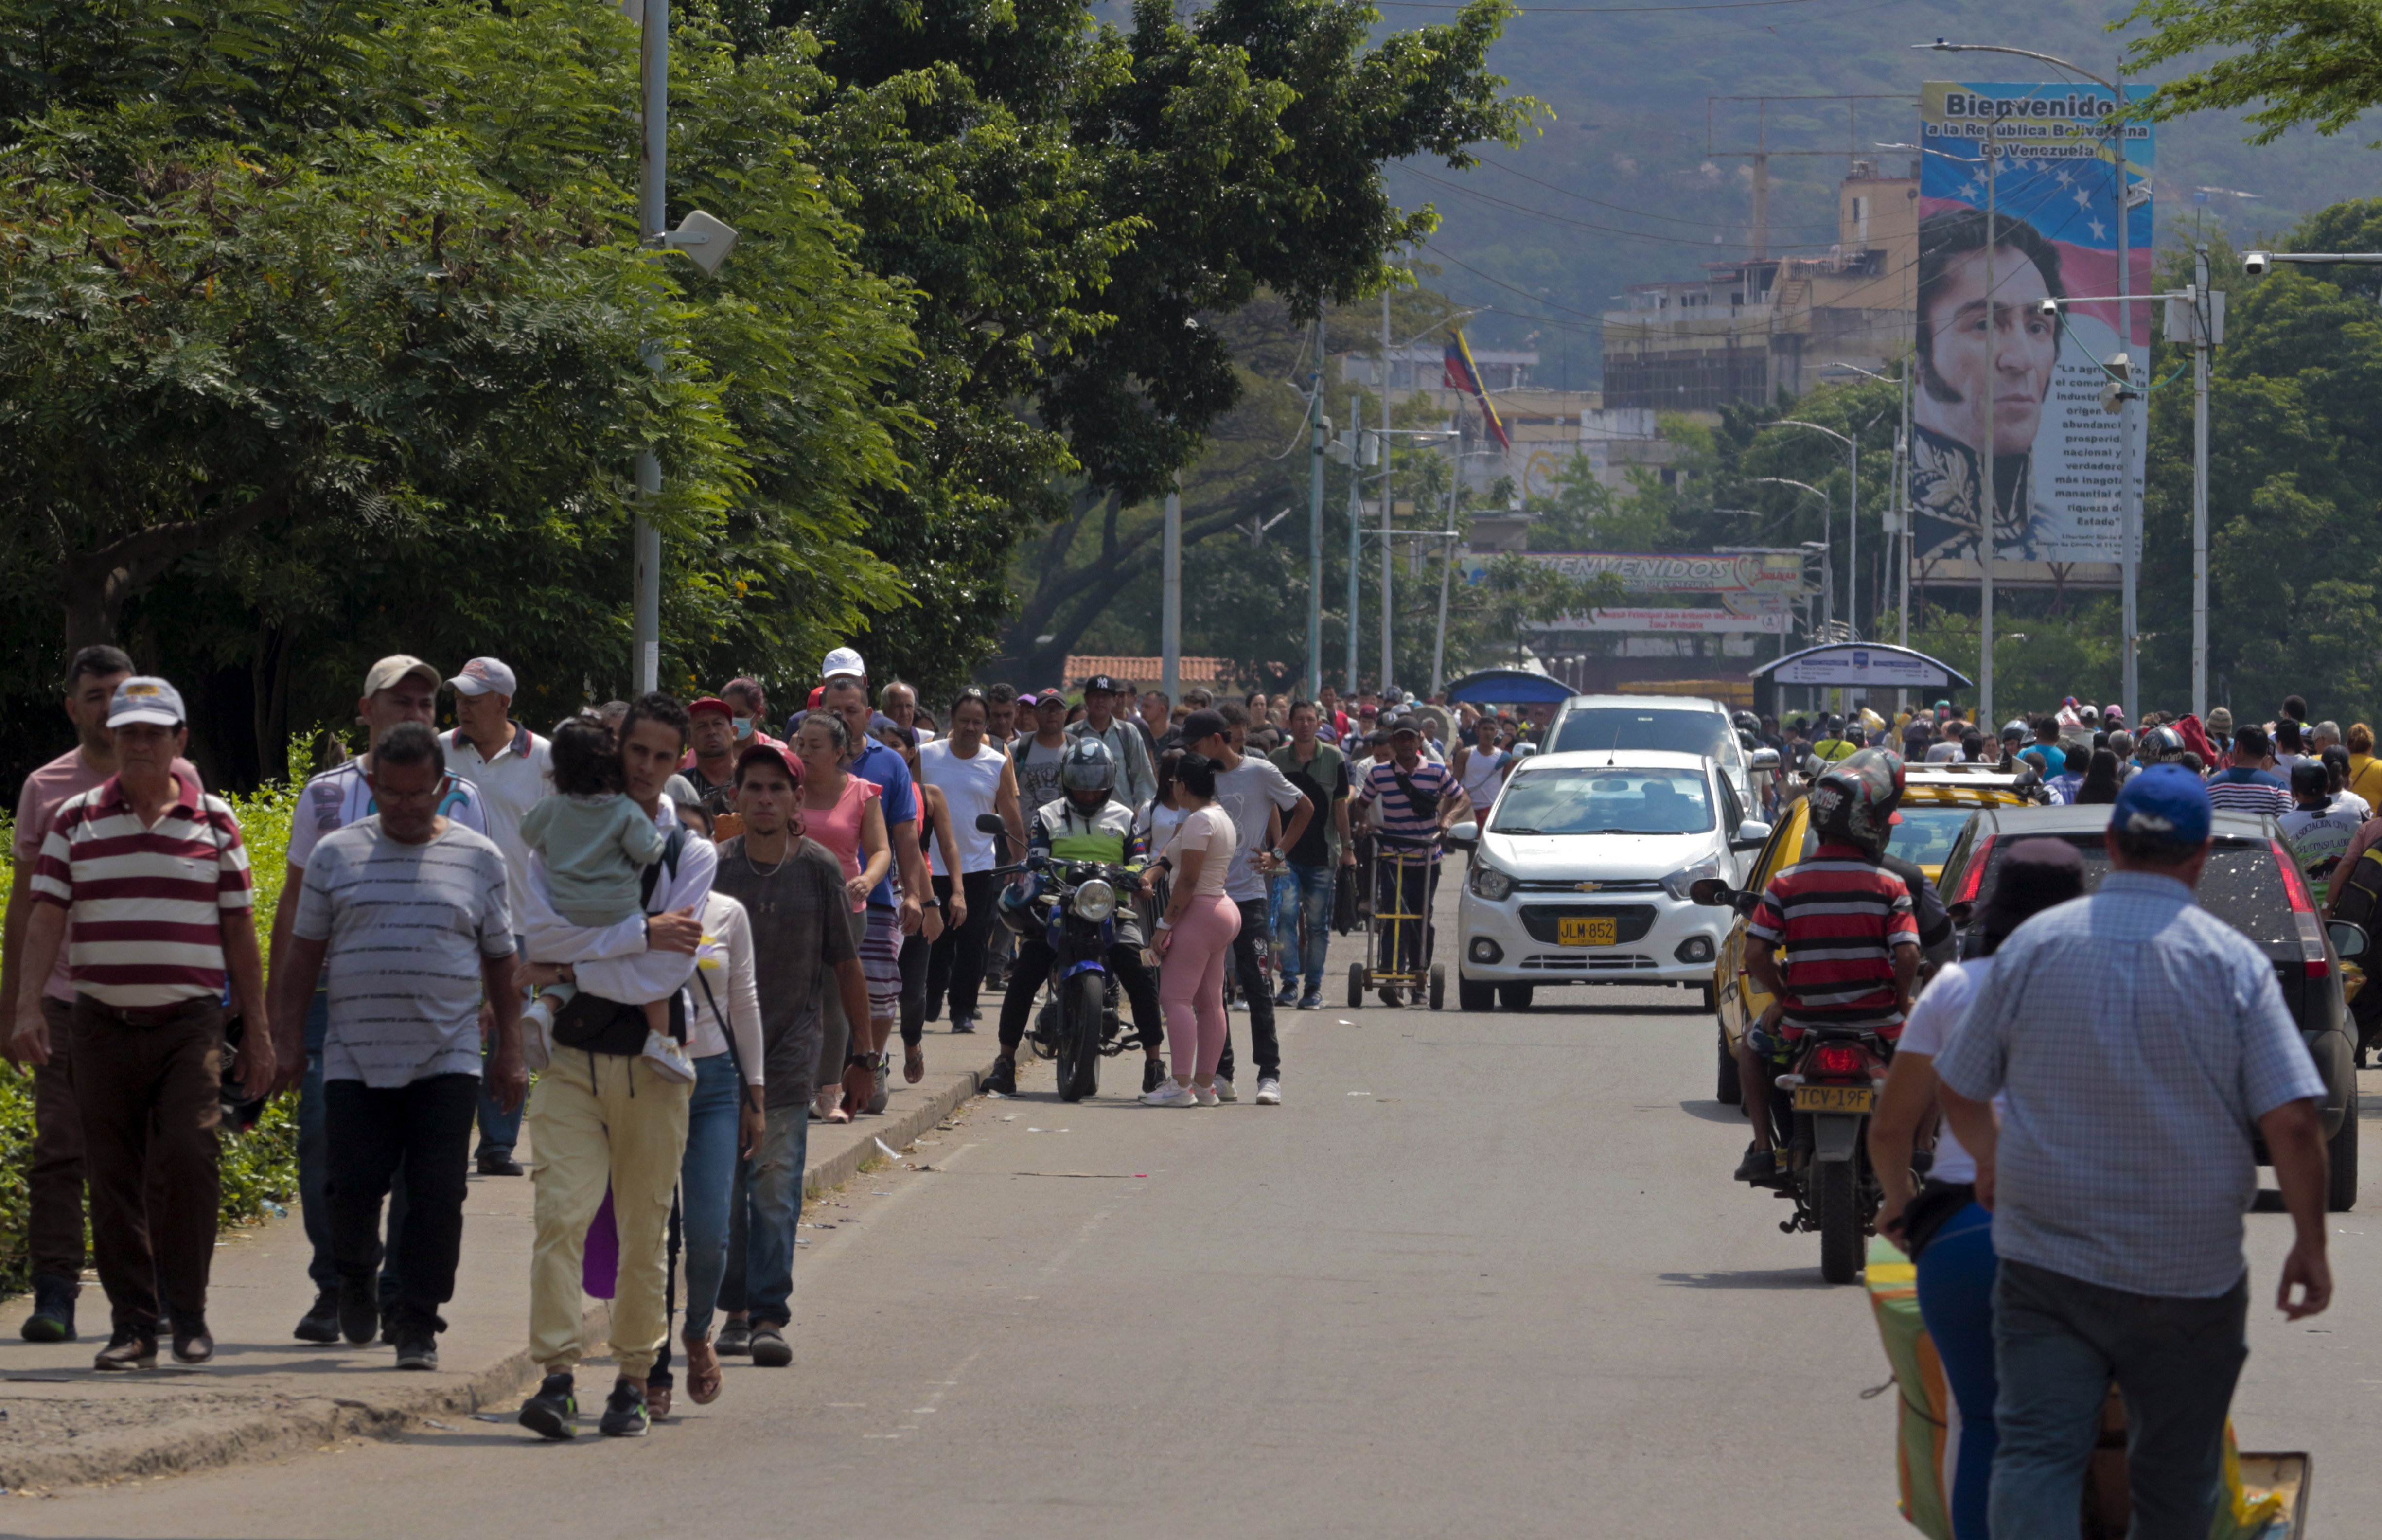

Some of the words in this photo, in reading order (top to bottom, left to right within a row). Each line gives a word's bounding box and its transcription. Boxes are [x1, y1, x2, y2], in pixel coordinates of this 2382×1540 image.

[1946, 93, 2130, 116] Bienvenido
[1928, 125, 1939, 135] a
[1944, 123, 1959, 135] la
[1966, 123, 2047, 139] Reública
[1981, 143, 2002, 156] De
[2008, 143, 2094, 156] Venezuela
[2066, 407, 2101, 416] origen
[2064, 448, 2112, 457] nacional
[2055, 475, 2079, 484] más
[2055, 490, 2111, 498] manantial
[2068, 504, 2109, 513] riqueza
